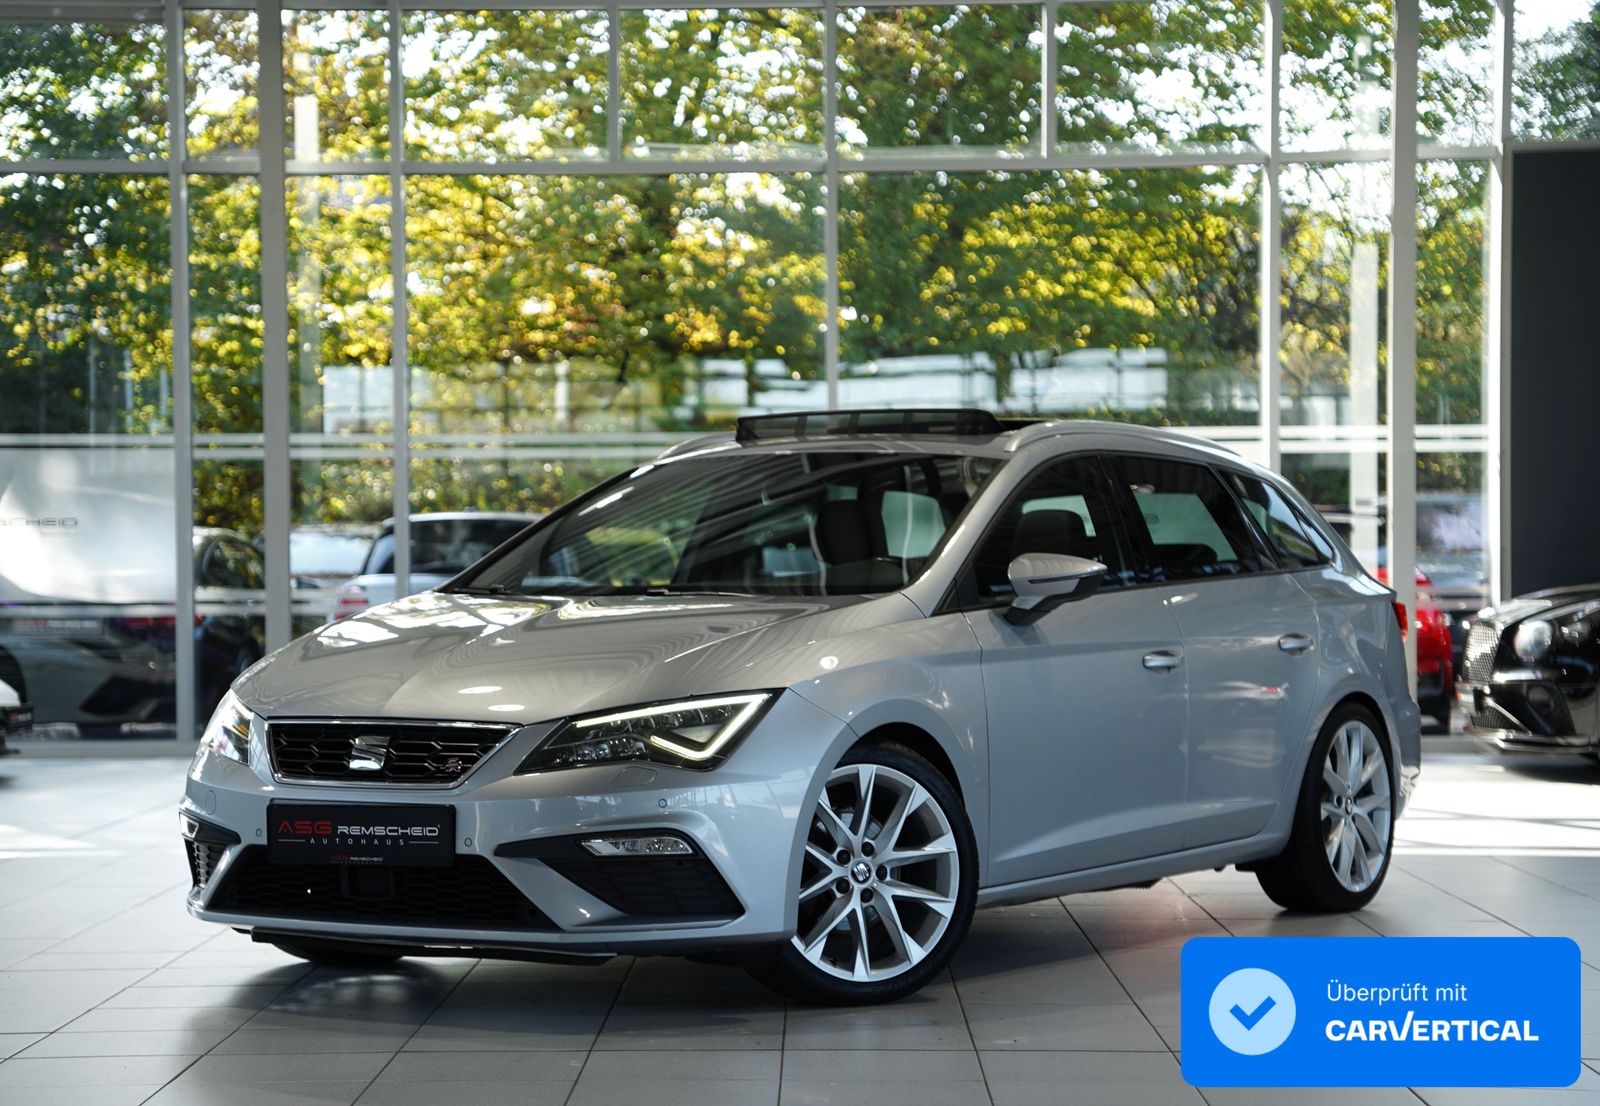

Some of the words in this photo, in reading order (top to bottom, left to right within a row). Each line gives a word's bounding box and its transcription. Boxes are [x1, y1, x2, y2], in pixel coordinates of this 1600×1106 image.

[278, 820, 332, 835] ASG
[337, 825, 439, 837] REMSCHEID
[310, 838, 404, 846] AUTOHAUS
